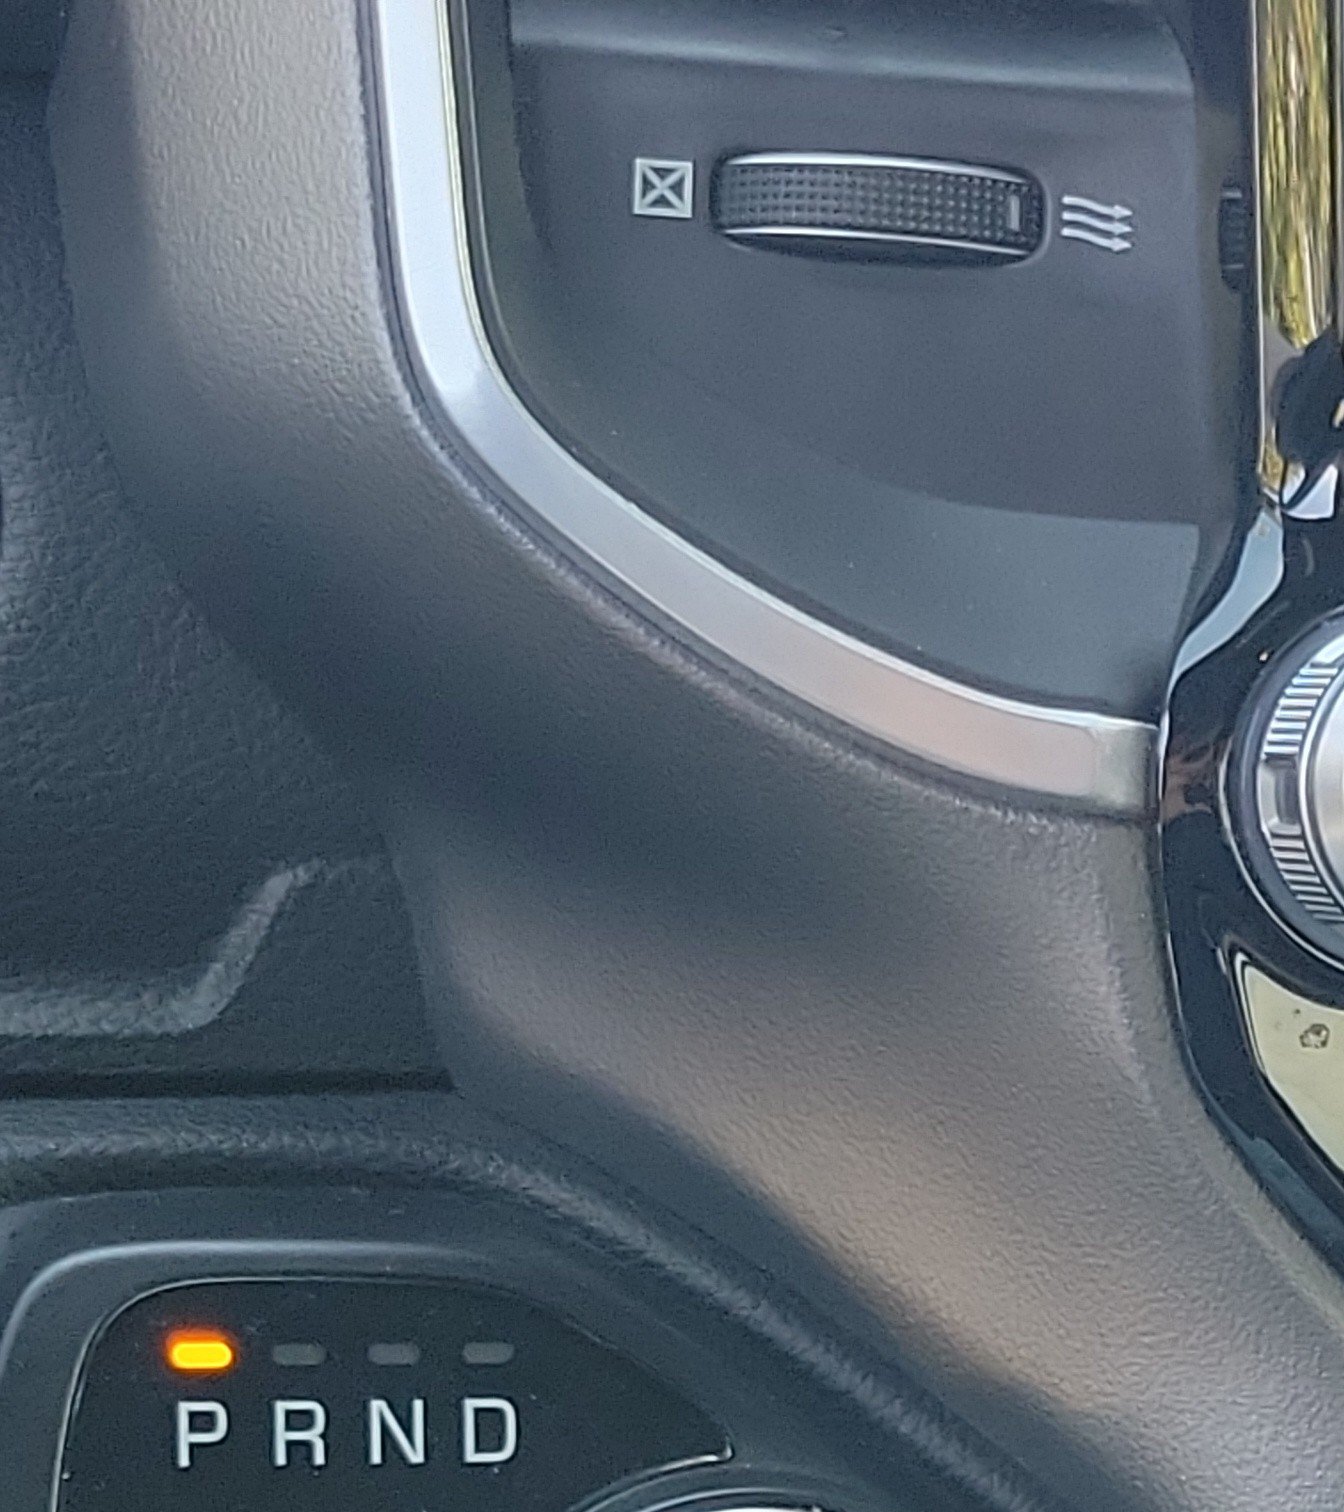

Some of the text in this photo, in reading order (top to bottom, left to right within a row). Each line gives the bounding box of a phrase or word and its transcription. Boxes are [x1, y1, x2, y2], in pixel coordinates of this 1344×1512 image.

[175, 1396, 520, 1467] P R N D
